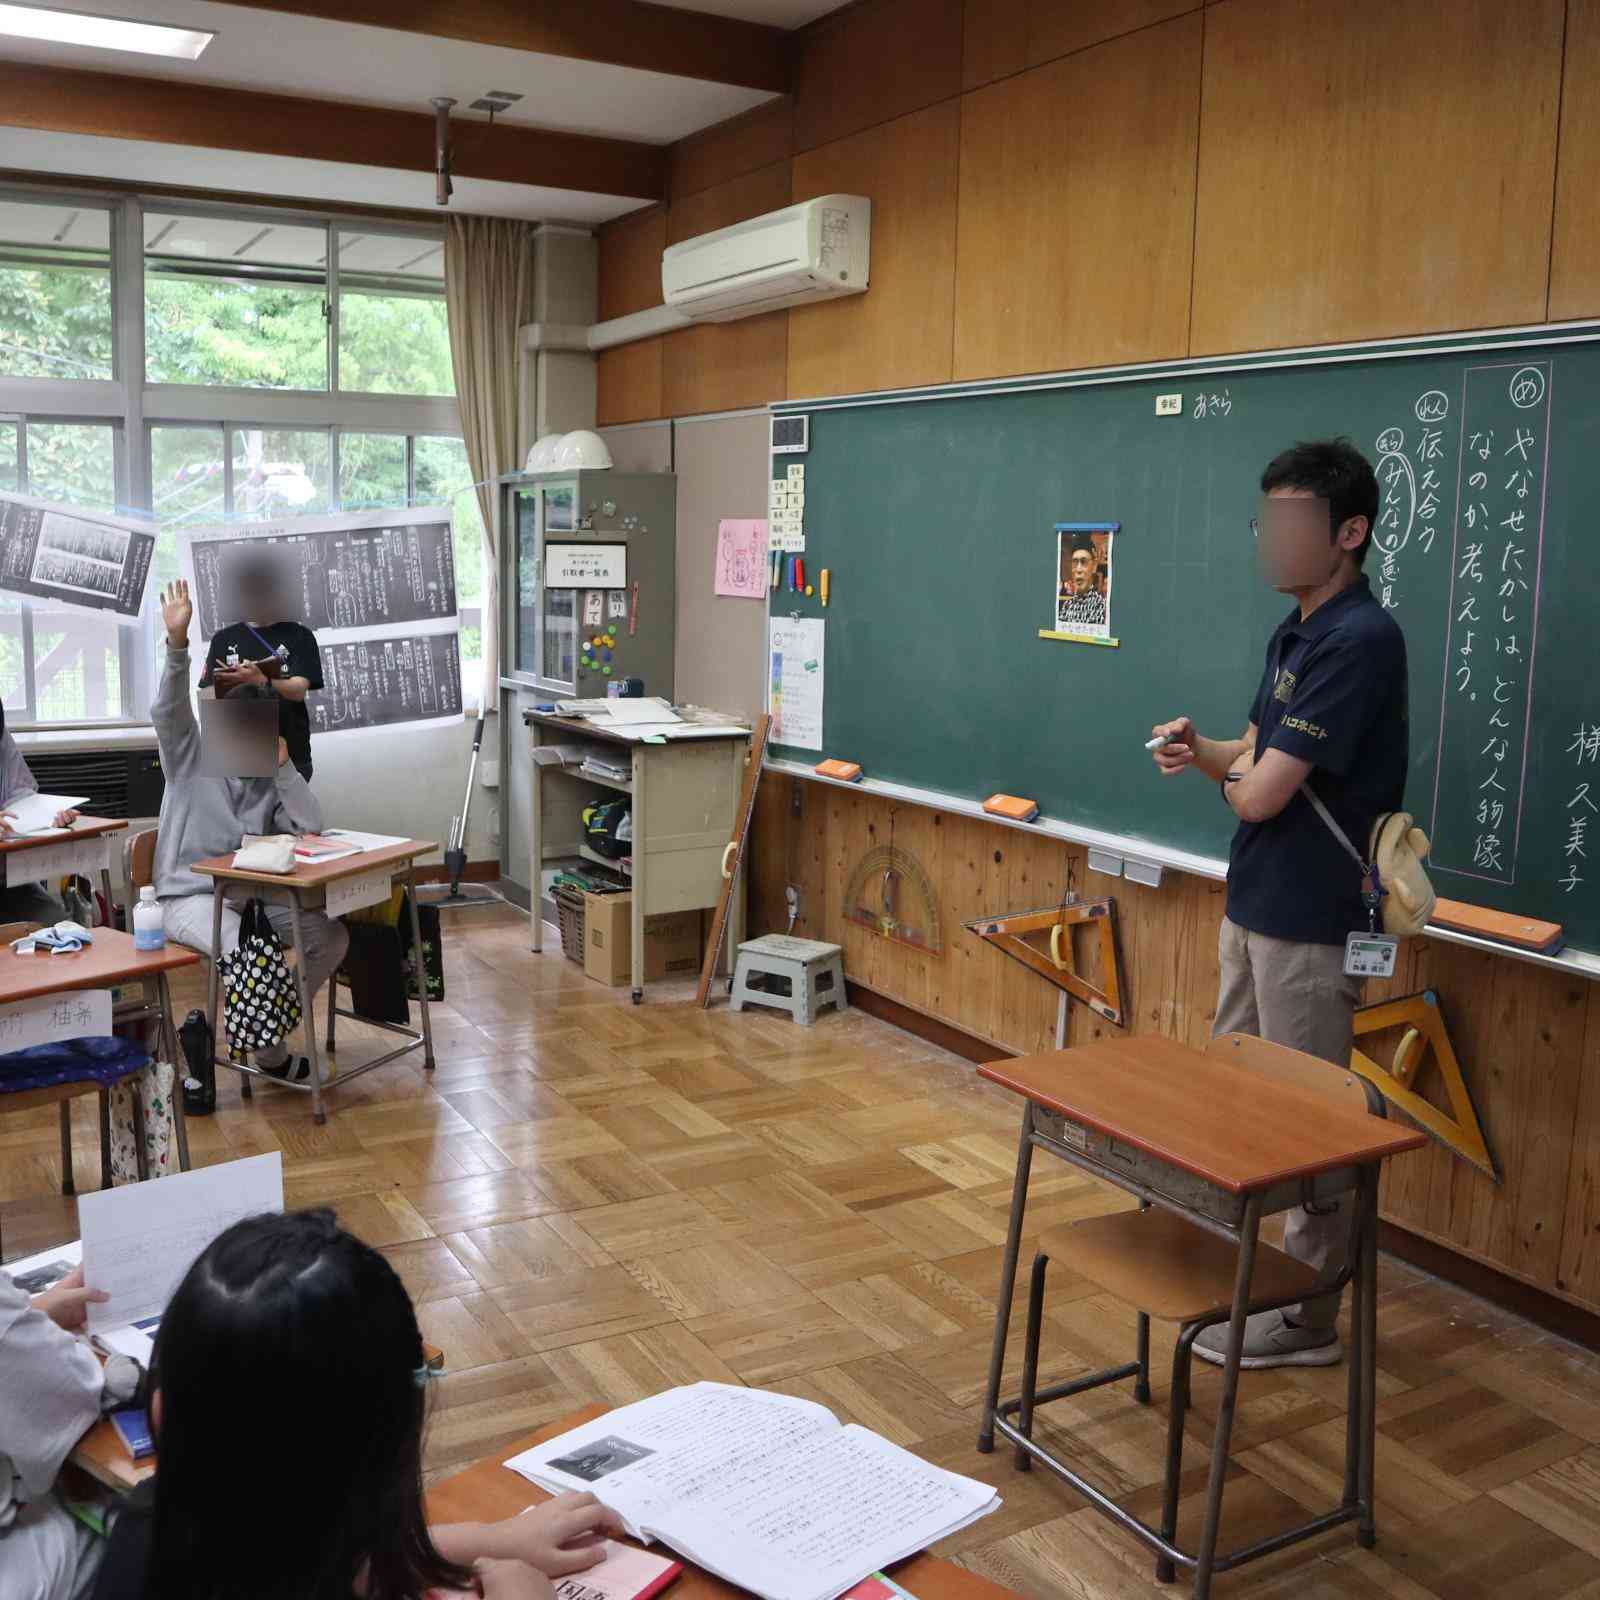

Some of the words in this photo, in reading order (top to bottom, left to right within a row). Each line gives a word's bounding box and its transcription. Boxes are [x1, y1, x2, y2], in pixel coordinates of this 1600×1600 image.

[1379, 462, 1404, 608] みんなの意見
[1416, 428, 1444, 552] 伝え合う
